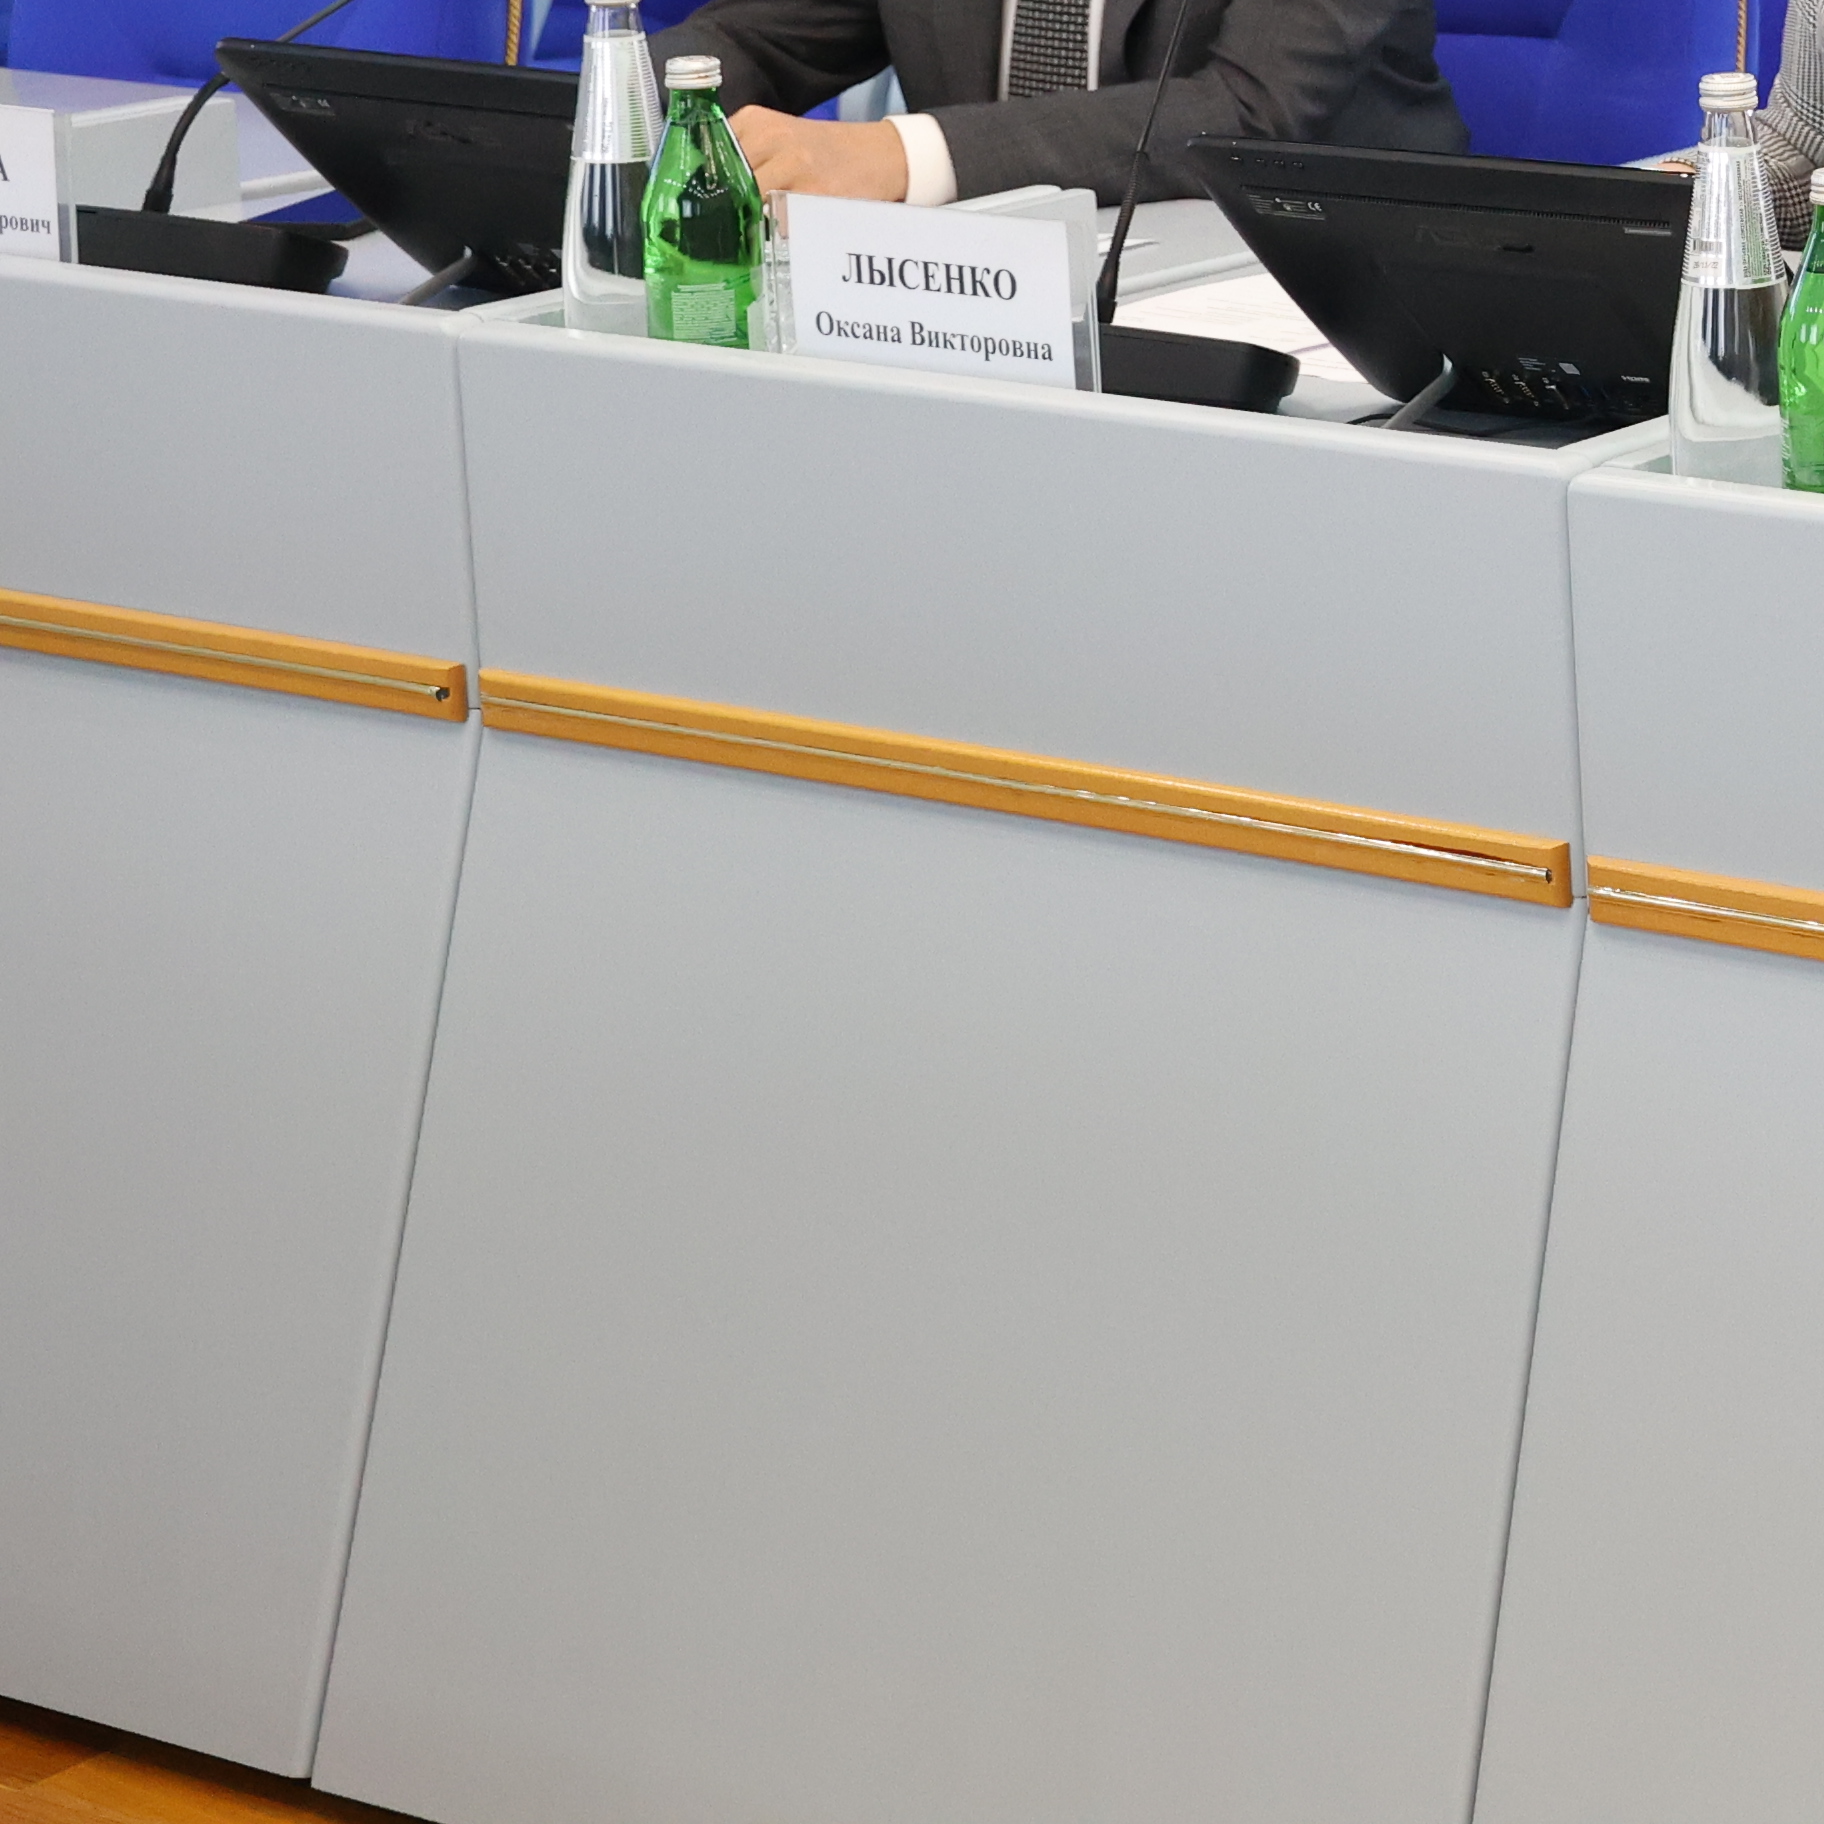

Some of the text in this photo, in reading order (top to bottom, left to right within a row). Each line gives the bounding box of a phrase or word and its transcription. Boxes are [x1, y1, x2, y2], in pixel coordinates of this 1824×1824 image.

[841, 253, 1017, 300] ЛЫСЕНКО
[815, 311, 1053, 361] Оксана Викторовна
